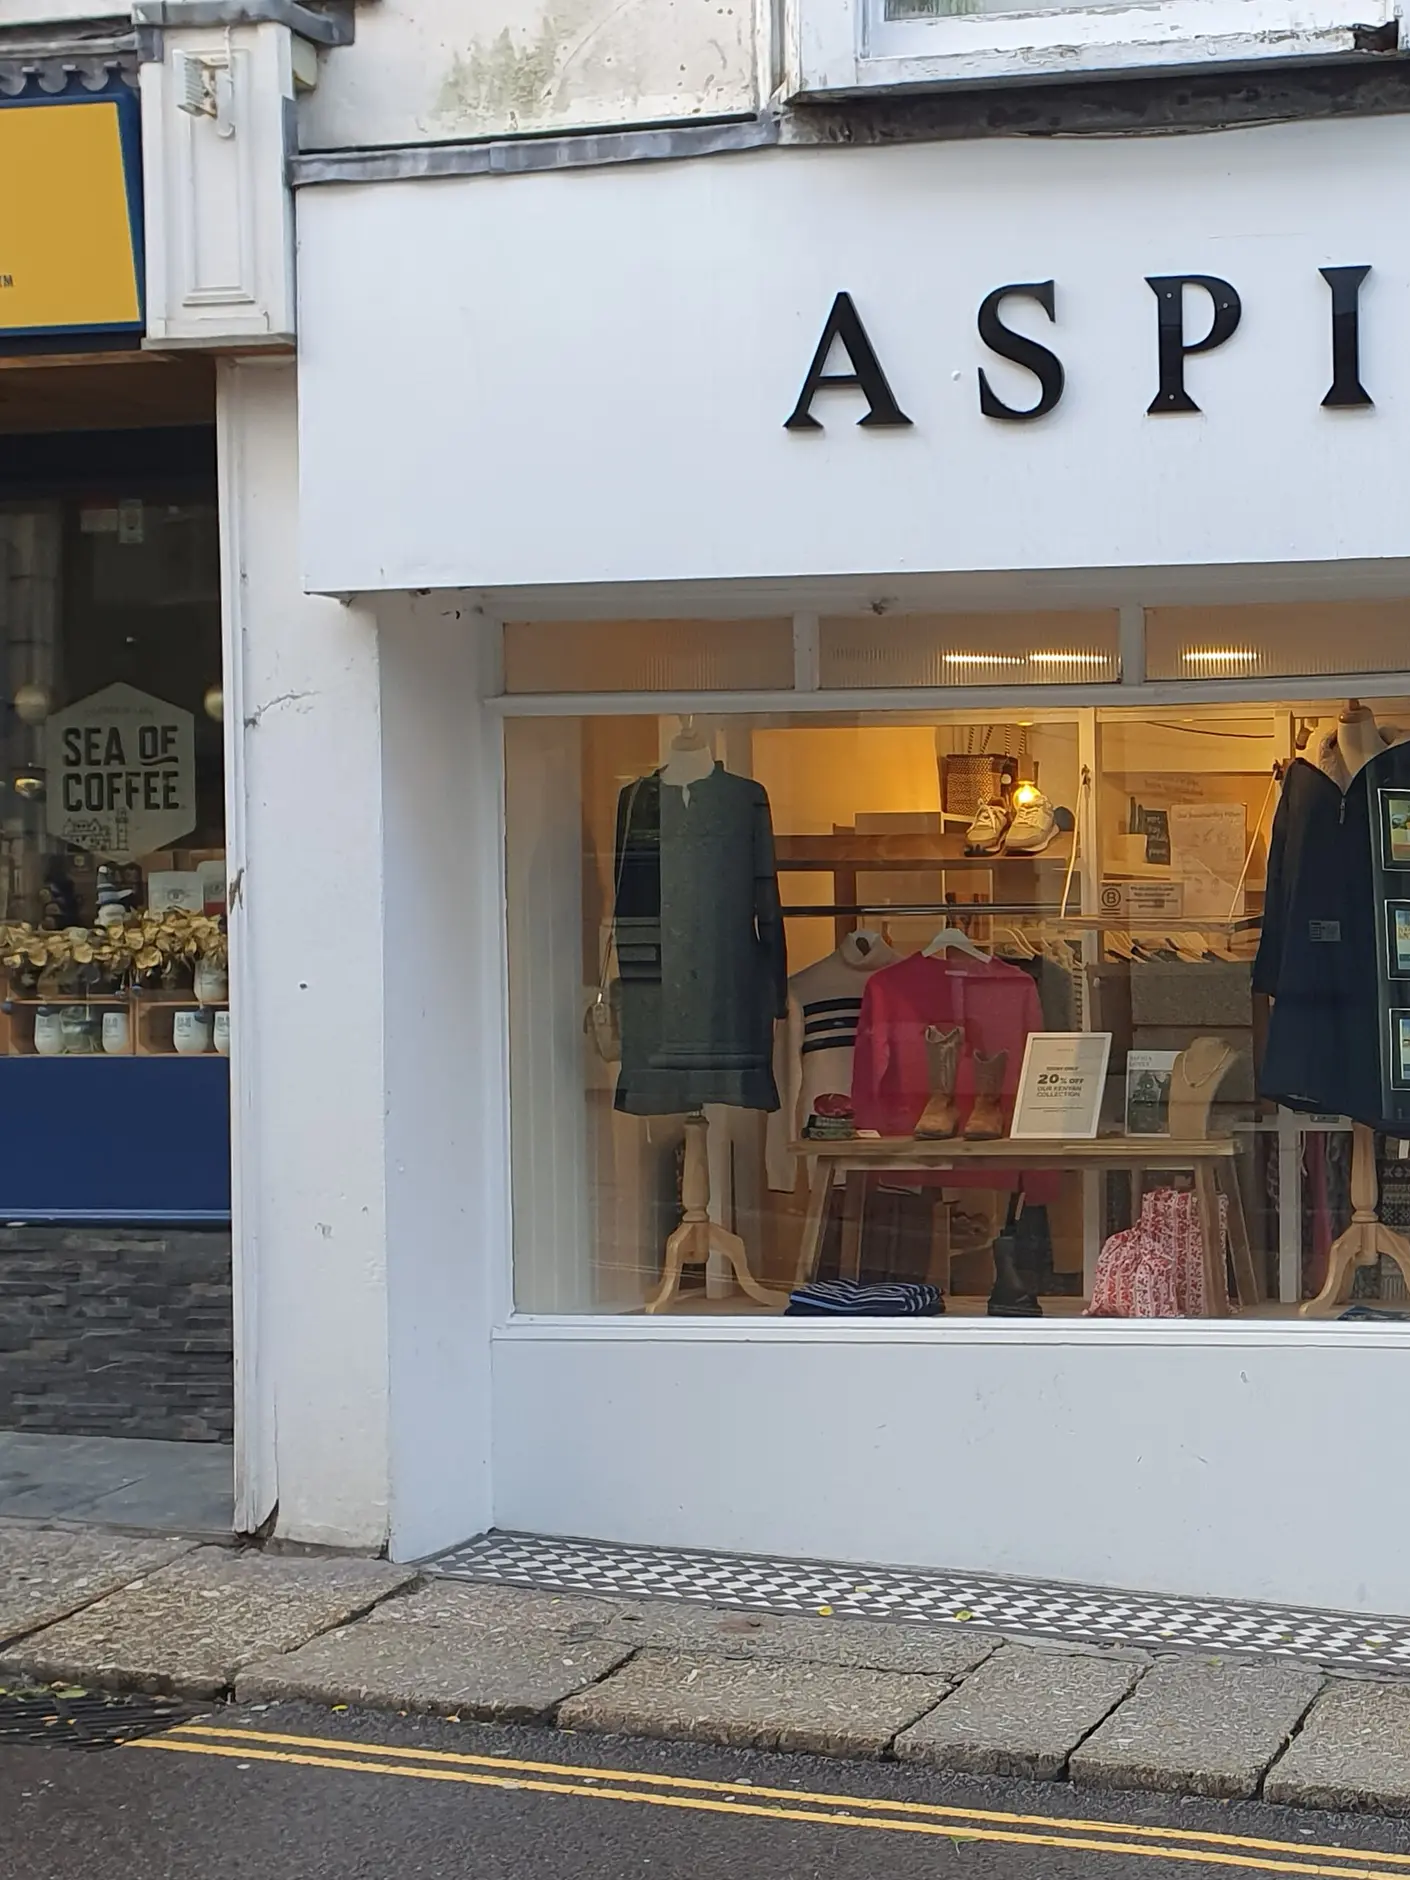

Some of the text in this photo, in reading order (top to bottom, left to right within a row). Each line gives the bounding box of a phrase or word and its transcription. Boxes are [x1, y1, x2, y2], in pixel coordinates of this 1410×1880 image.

[63, 725, 179, 767] SEA OF
[63, 770, 180, 812] COFFEE
